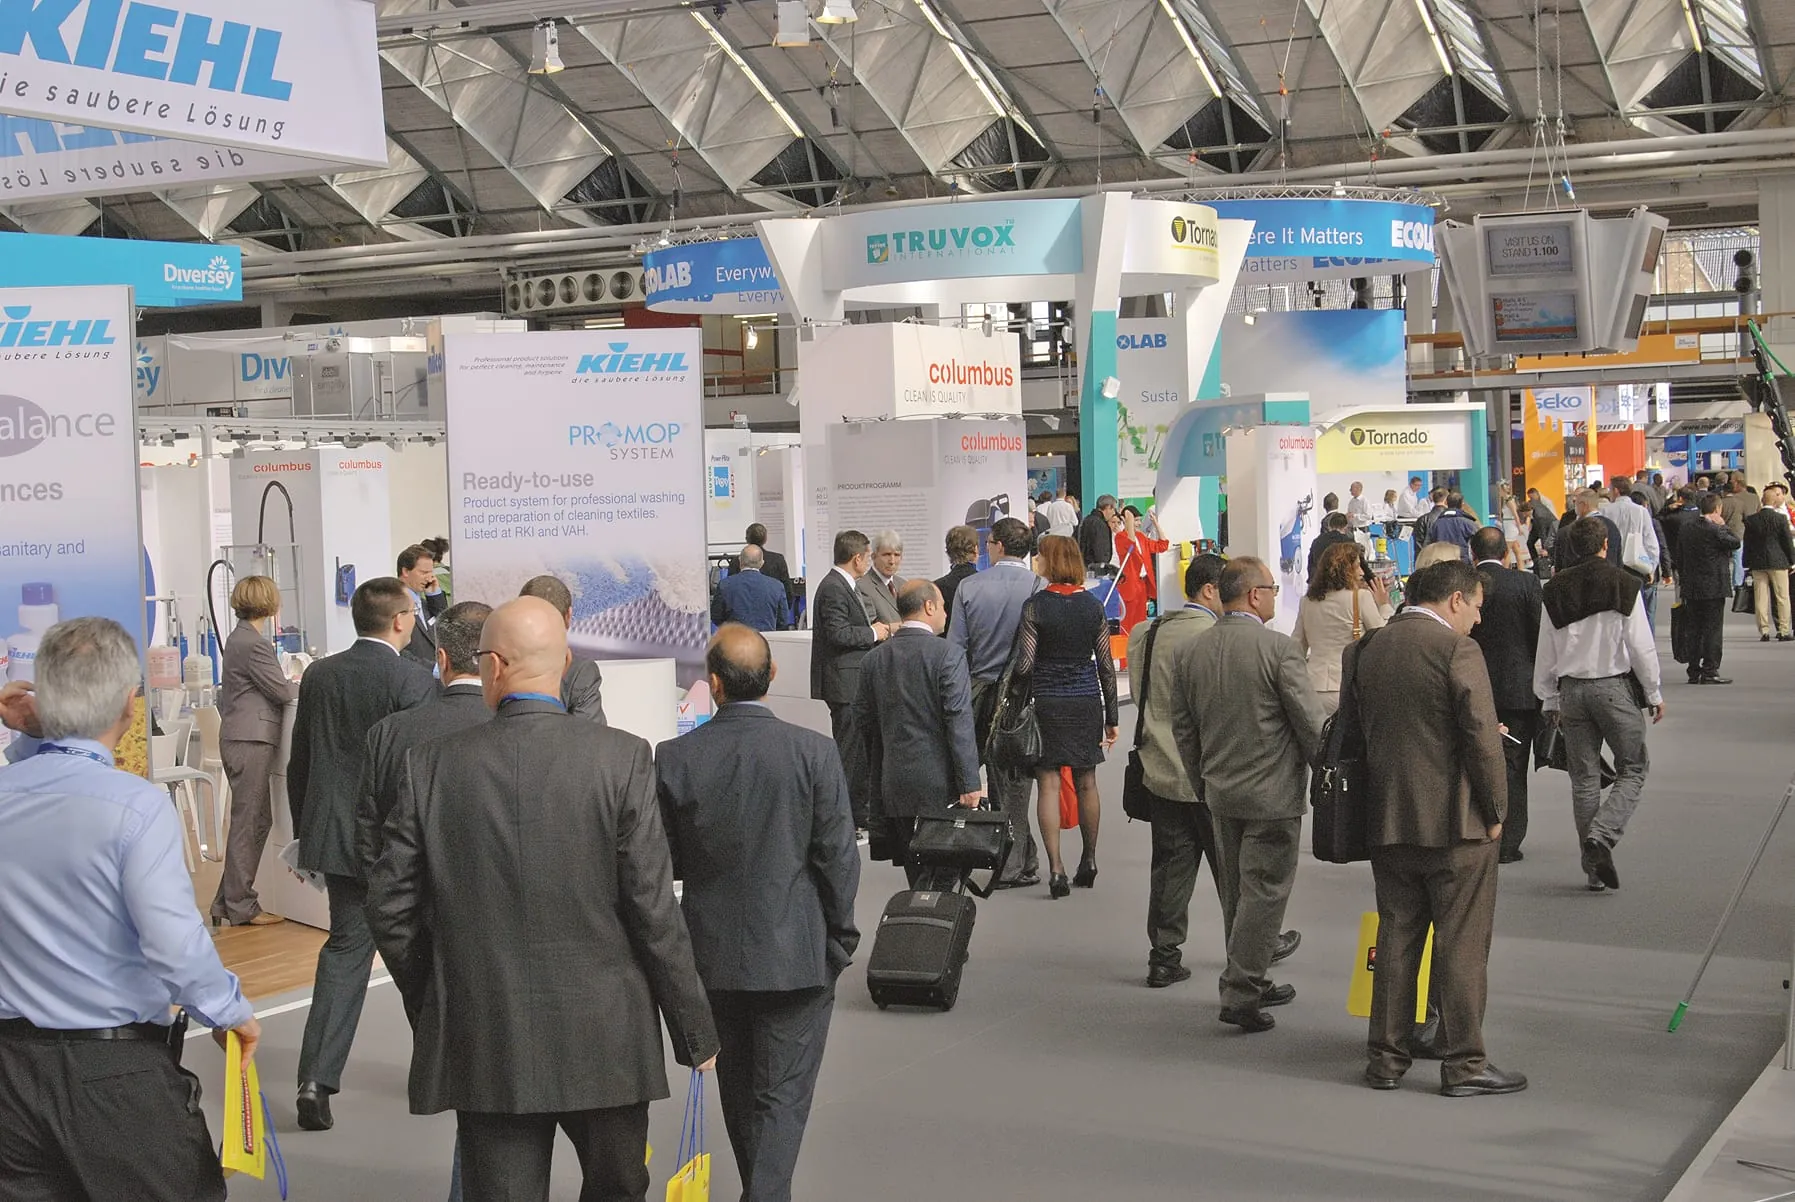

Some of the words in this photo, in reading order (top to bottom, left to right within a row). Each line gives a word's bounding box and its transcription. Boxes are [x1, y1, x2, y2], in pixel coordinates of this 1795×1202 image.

[0, 0, 293, 101] KIEHL
[0, 72, 30, 97] ie
[46, 84, 170, 118] saubere
[187, 102, 286, 140] Lösung
[892, 225, 1016, 253] TRUVOX
[1186, 219, 1218, 248] Torna
[1249, 230, 1276, 245] ere
[1282, 228, 1295, 244] It
[1301, 227, 1364, 246] Matters
[1504, 236, 1525, 247] VISIT
[1527, 236, 1539, 246] US
[1541, 235, 1554, 245] ON
[893, 247, 1016, 262] INTERNATIONAL
[1502, 247, 1532, 258] STAND
[1534, 246, 1559, 257] 1.100
[163, 262, 235, 289] Diversey
[645, 261, 693, 295] OLAB
[716, 265, 776, 283] Everyw
[0, 319, 116, 347] IEHL
[1116, 333, 1167, 350] OLAB
[0, 352, 47, 361] ubere
[576, 352, 689, 374] KIEHL
[571, 376, 590, 384] die
[594, 375, 640, 384] saubere
[929, 358, 1014, 387] columbus
[904, 389, 928, 403] CLEAN
[930, 390, 936, 403] IS
[938, 390, 966, 404] QUALITY
[0, 405, 116, 440] alance
[961, 431, 1023, 452] columbus
[1279, 435, 1314, 450] columbus
[1365, 427, 1428, 445] Tornado
[609, 447, 674, 460] SYSTEM
[253, 462, 311, 473] columbus
[338, 459, 382, 470] columbus
[463, 471, 594, 492] Ready-to-use
[0, 481, 63, 501] nces
[463, 496, 507, 508] Product
[510, 496, 550, 511] system
[553, 494, 567, 505] for
[570, 492, 637, 507] professional
[640, 491, 685, 505] washing
[463, 513, 485, 524] and
[488, 510, 550, 526] preparation
[553, 510, 565, 521] of
[567, 508, 613, 523] cleaning
[616, 508, 659, 520] textiles.
[464, 527, 498, 540] Listed
[501, 528, 511, 539] at
[515, 526, 534, 538] RKI
[537, 525, 559, 538] and
[561, 525, 589, 537] VAH.
[57, 539, 85, 555] and
